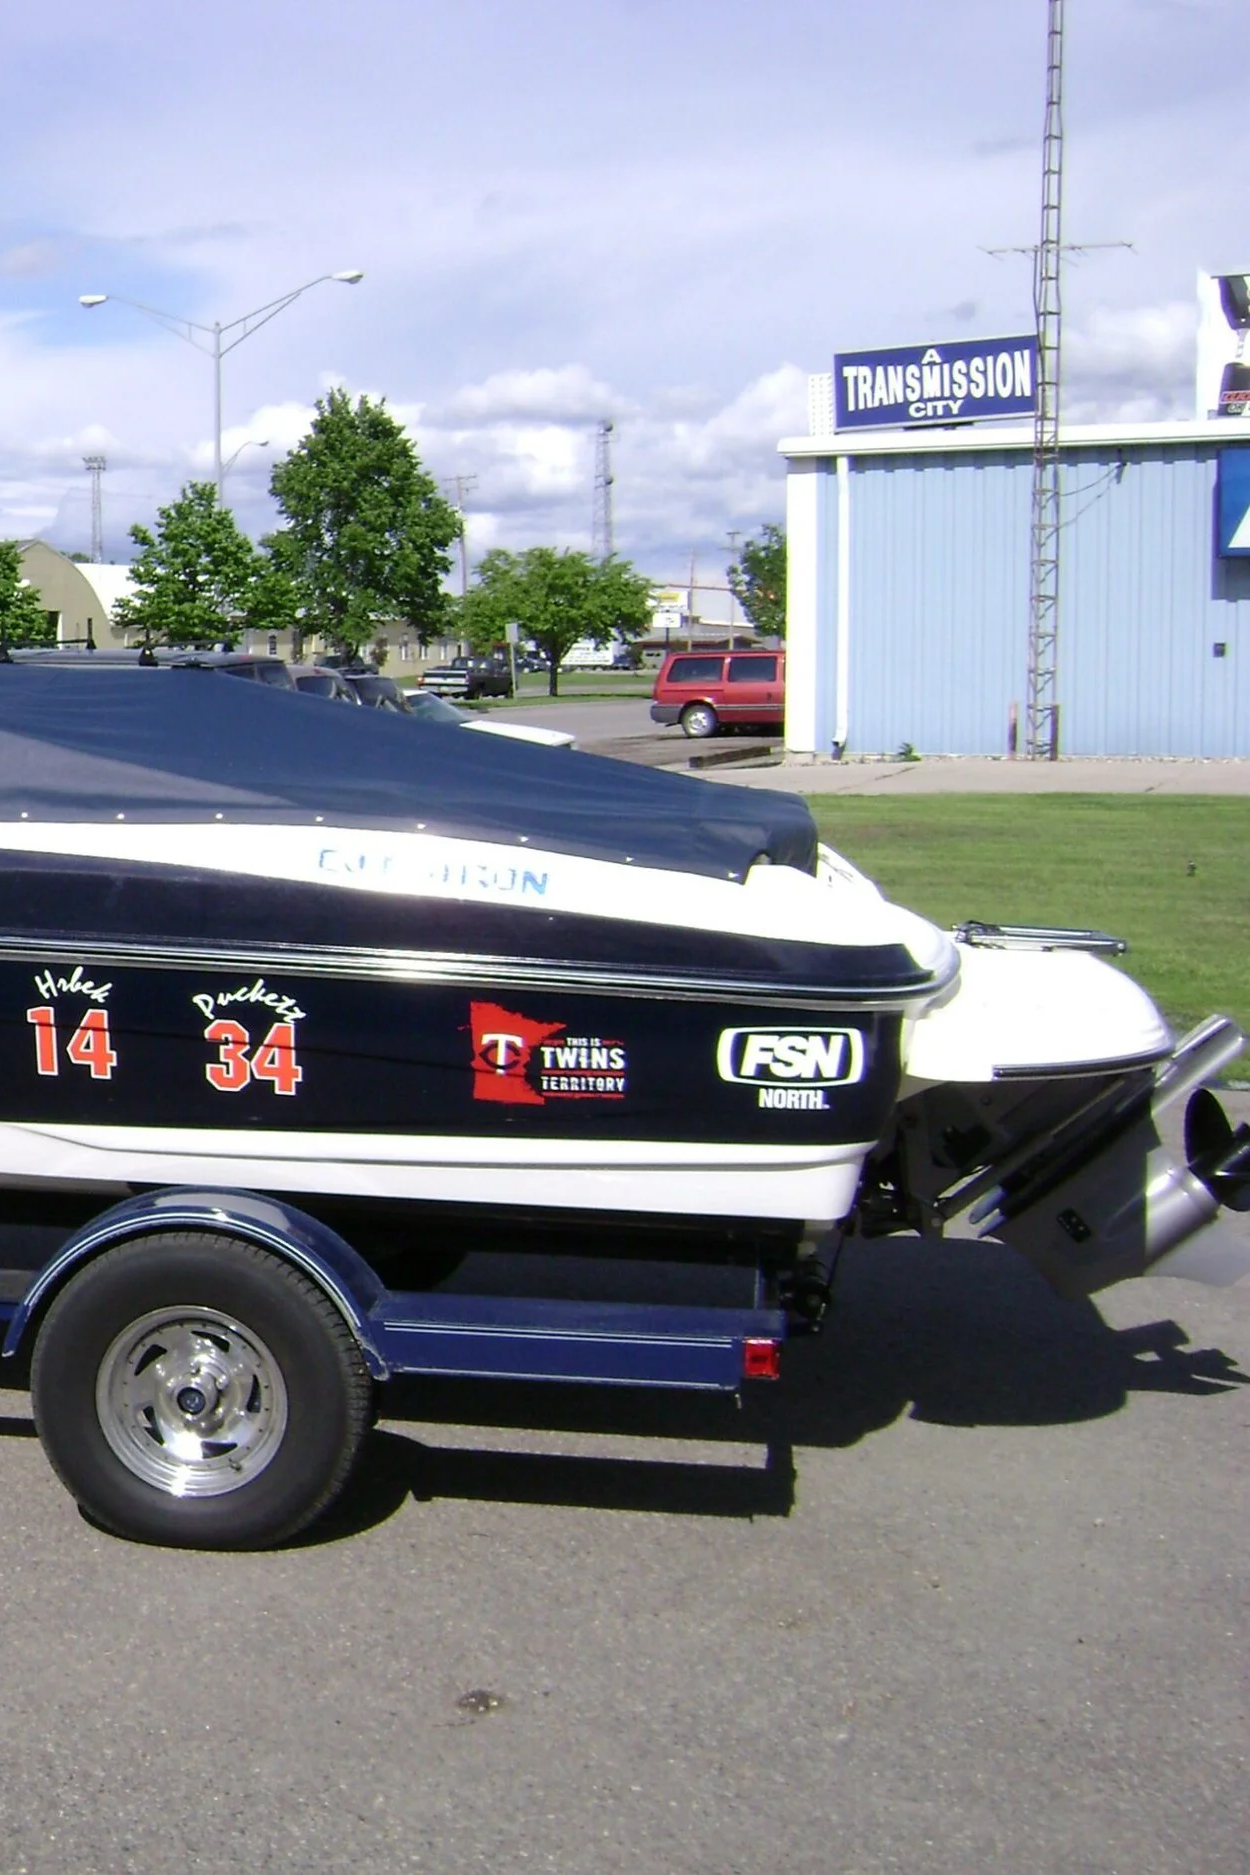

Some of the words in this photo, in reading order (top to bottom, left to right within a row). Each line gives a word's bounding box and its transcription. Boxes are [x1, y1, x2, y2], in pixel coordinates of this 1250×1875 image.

[921, 349, 942, 364] A
[843, 349, 1032, 412] TRANSMISSION
[908, 400, 964, 418] CITY
[34, 966, 113, 1003] Hrbek
[27, 1006, 117, 1080] 14
[566, 1037, 588, 1047] THIS
[590, 1037, 601, 1046] IS
[204, 1019, 303, 1096] 34
[540, 1046, 625, 1070] TWINS
[739, 1034, 845, 1079] FSN
[540, 1076, 625, 1092] TERRITORY
[758, 1088, 824, 1110] NORTH
